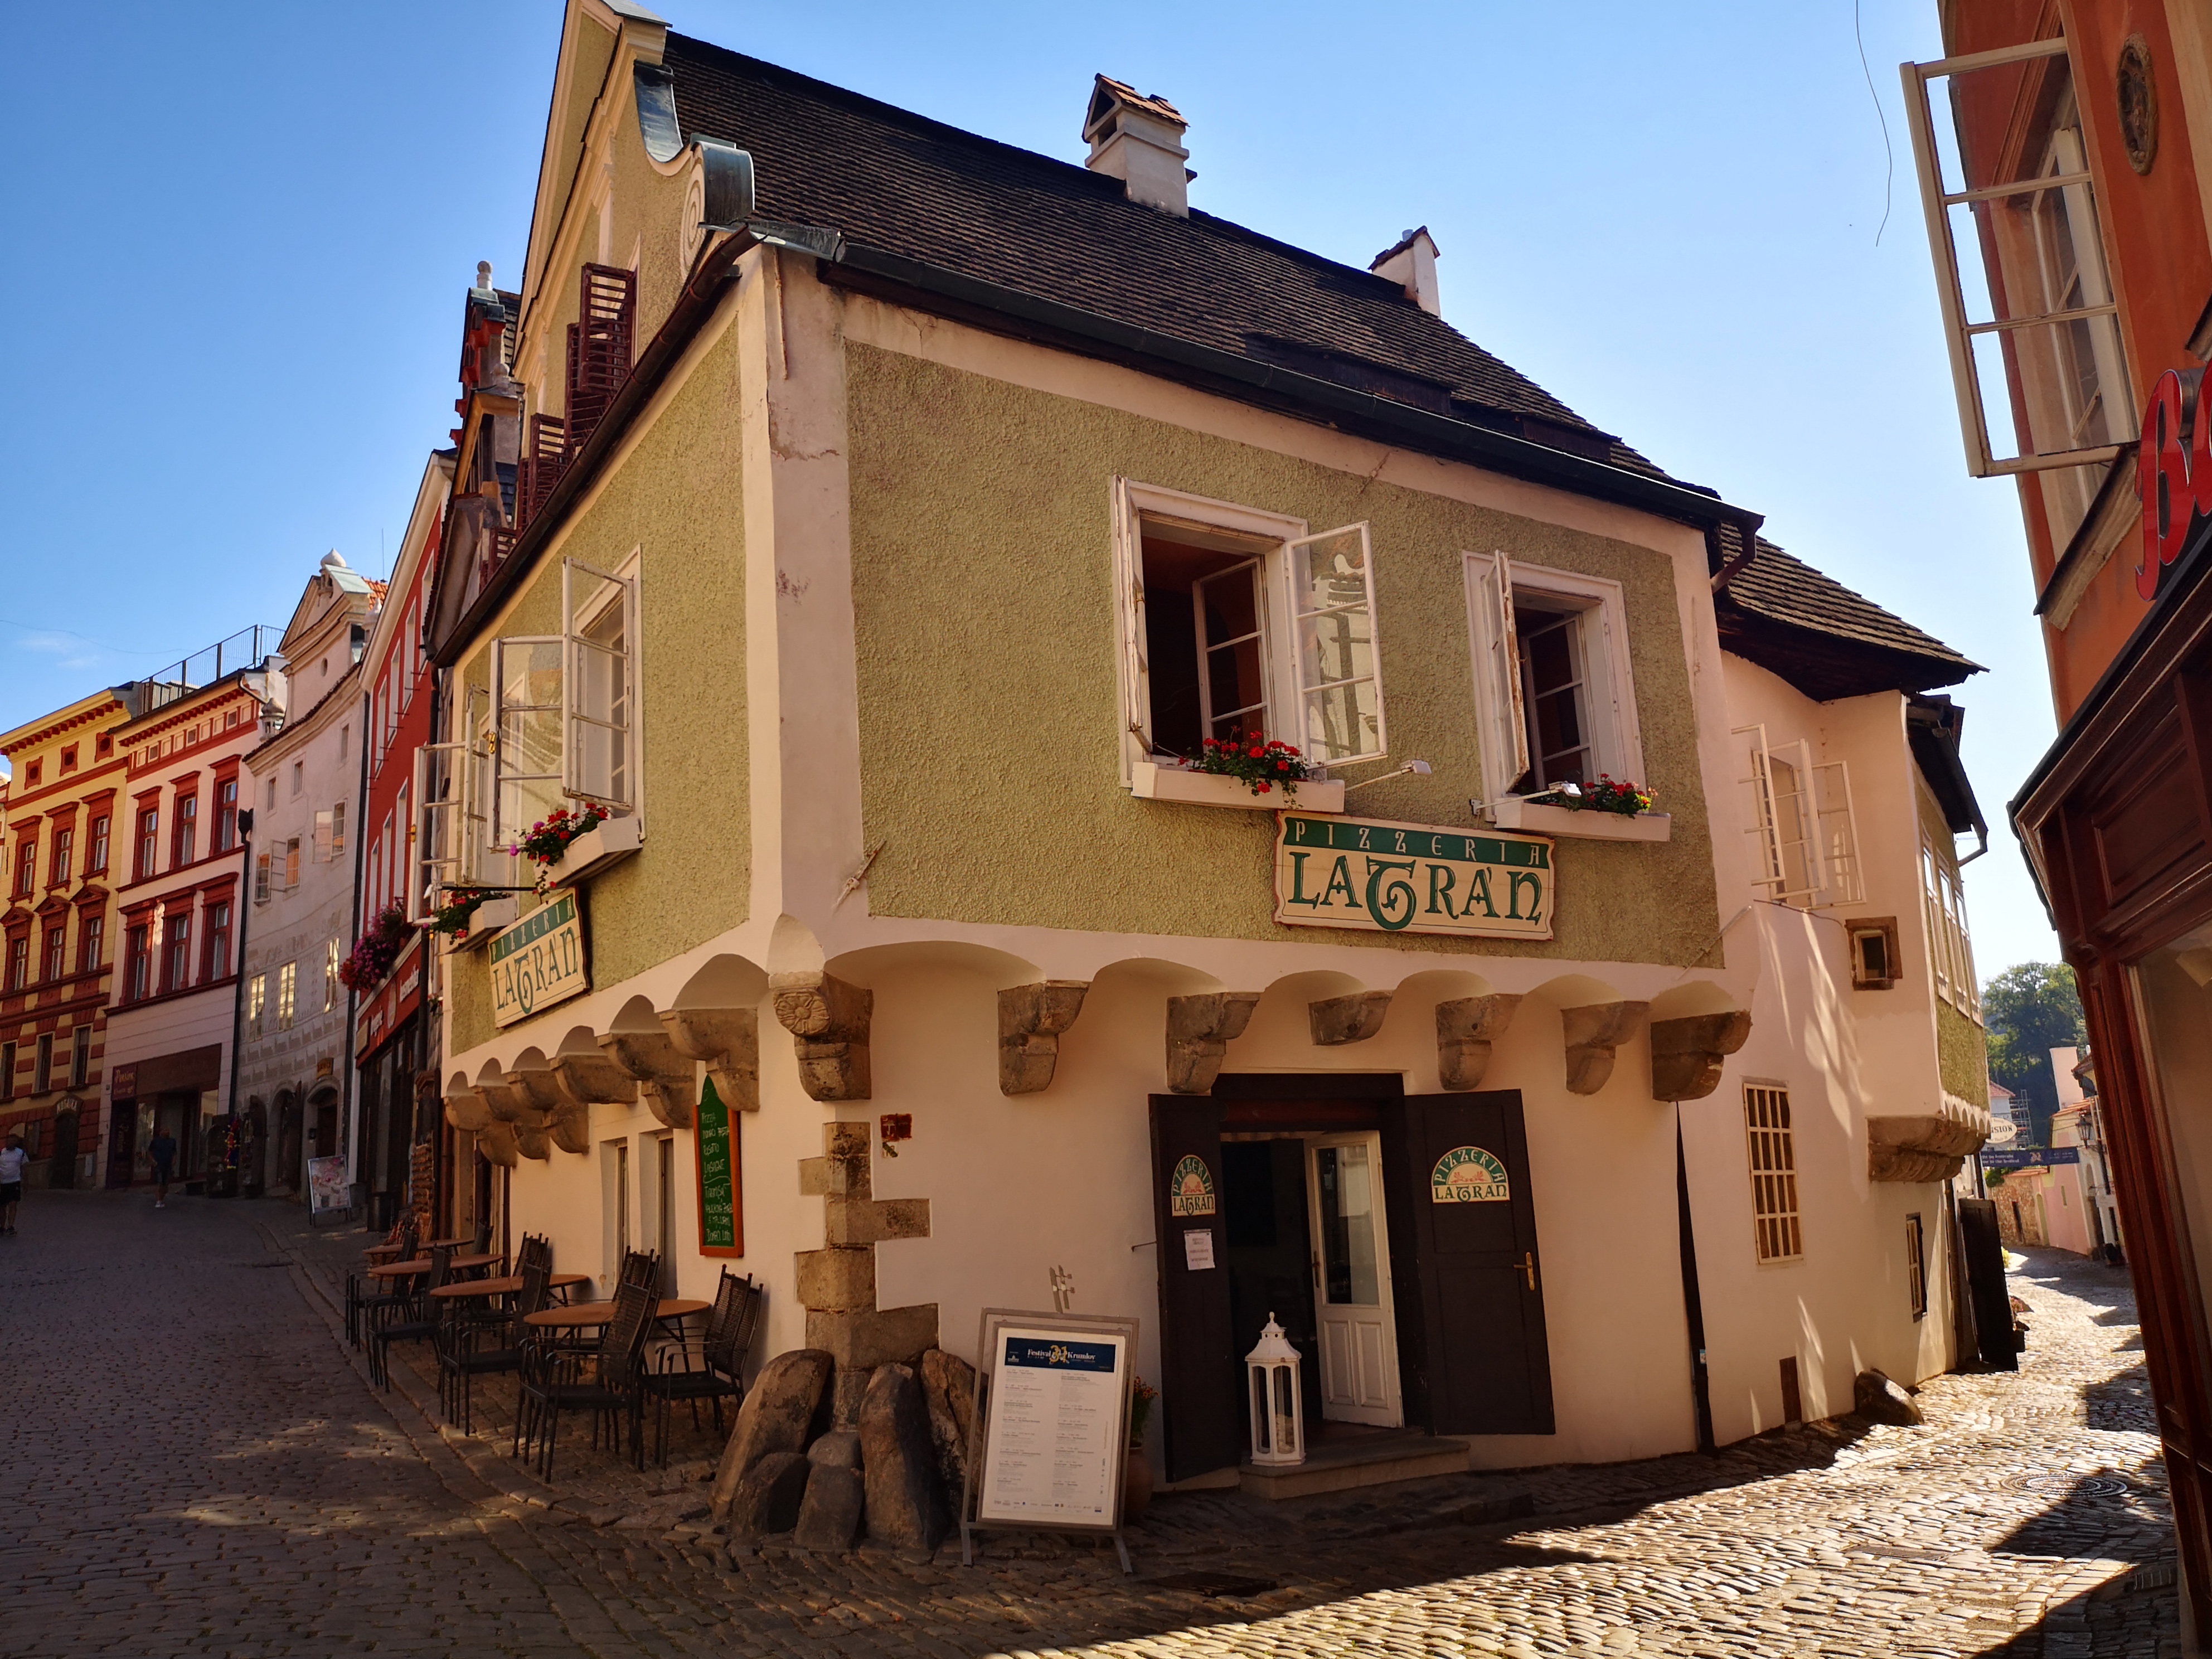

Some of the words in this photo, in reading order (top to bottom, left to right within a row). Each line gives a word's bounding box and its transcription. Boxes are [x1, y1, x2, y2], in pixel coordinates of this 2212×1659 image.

[1295, 820, 1540, 865] PIZZERIA
[492, 896, 573, 961] PIZZERIA
[1173, 1159, 1212, 1193] PIZZERIA
[1434, 1149, 1505, 1183] PIZZERIA
[1028, 1349, 1051, 1358] Festival
[1050, 1345, 1068, 1363] 31
[1068, 1352, 1095, 1360] Krumlov
